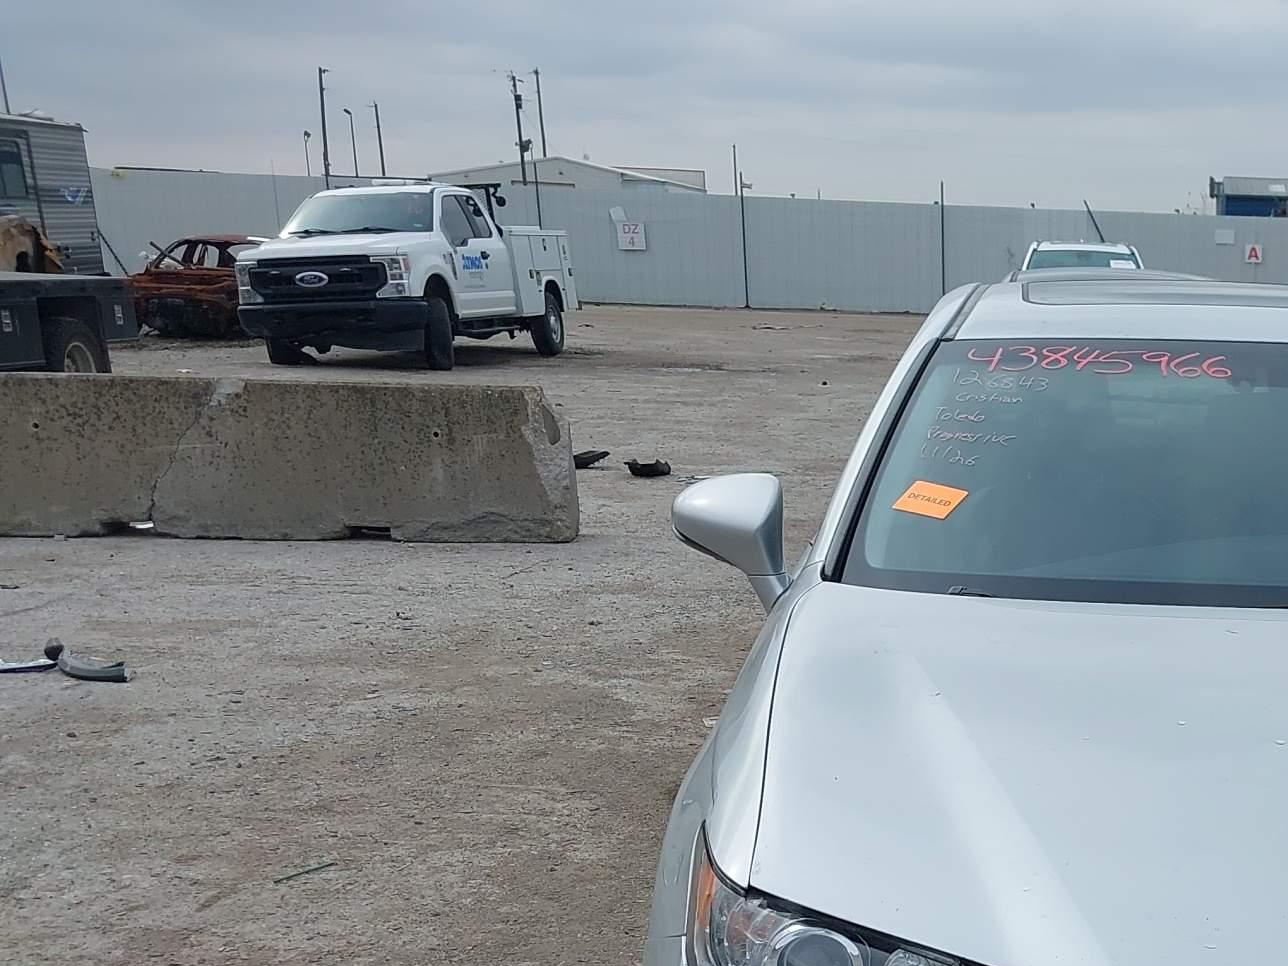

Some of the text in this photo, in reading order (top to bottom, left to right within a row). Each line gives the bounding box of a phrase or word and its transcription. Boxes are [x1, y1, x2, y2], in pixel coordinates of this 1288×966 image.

[622, 223, 640, 234] DZ
[1247, 246, 1260, 261] A
[967, 345, 1232, 378] 43845966
[907, 492, 952, 507] DETAILED
